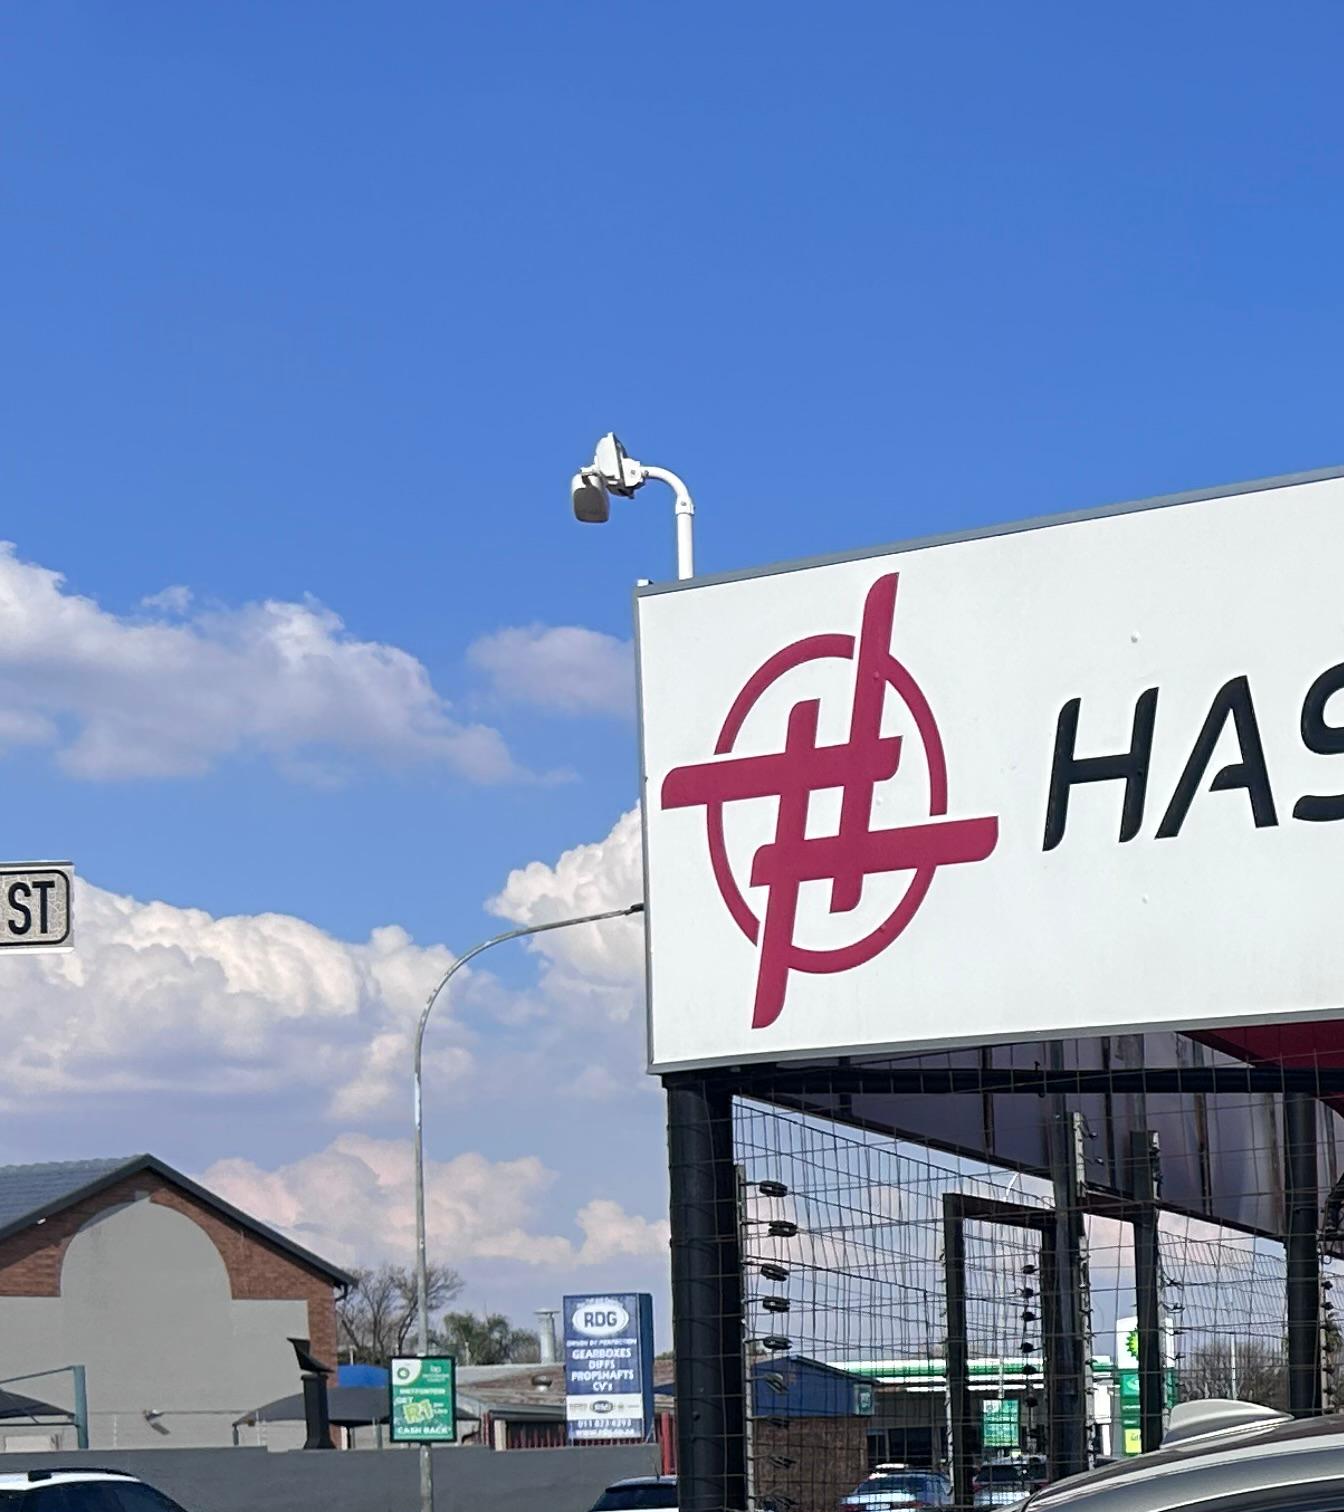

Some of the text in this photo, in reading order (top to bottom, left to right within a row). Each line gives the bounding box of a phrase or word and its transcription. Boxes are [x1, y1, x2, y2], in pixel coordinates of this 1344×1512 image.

[8, 881, 55, 934] ST
[584, 1312, 617, 1327] RDG
[572, 1348, 631, 1359] GEARBOXES
[588, 1360, 615, 1369] DIFFS
[571, 1370, 634, 1381] PROPSHAFTS
